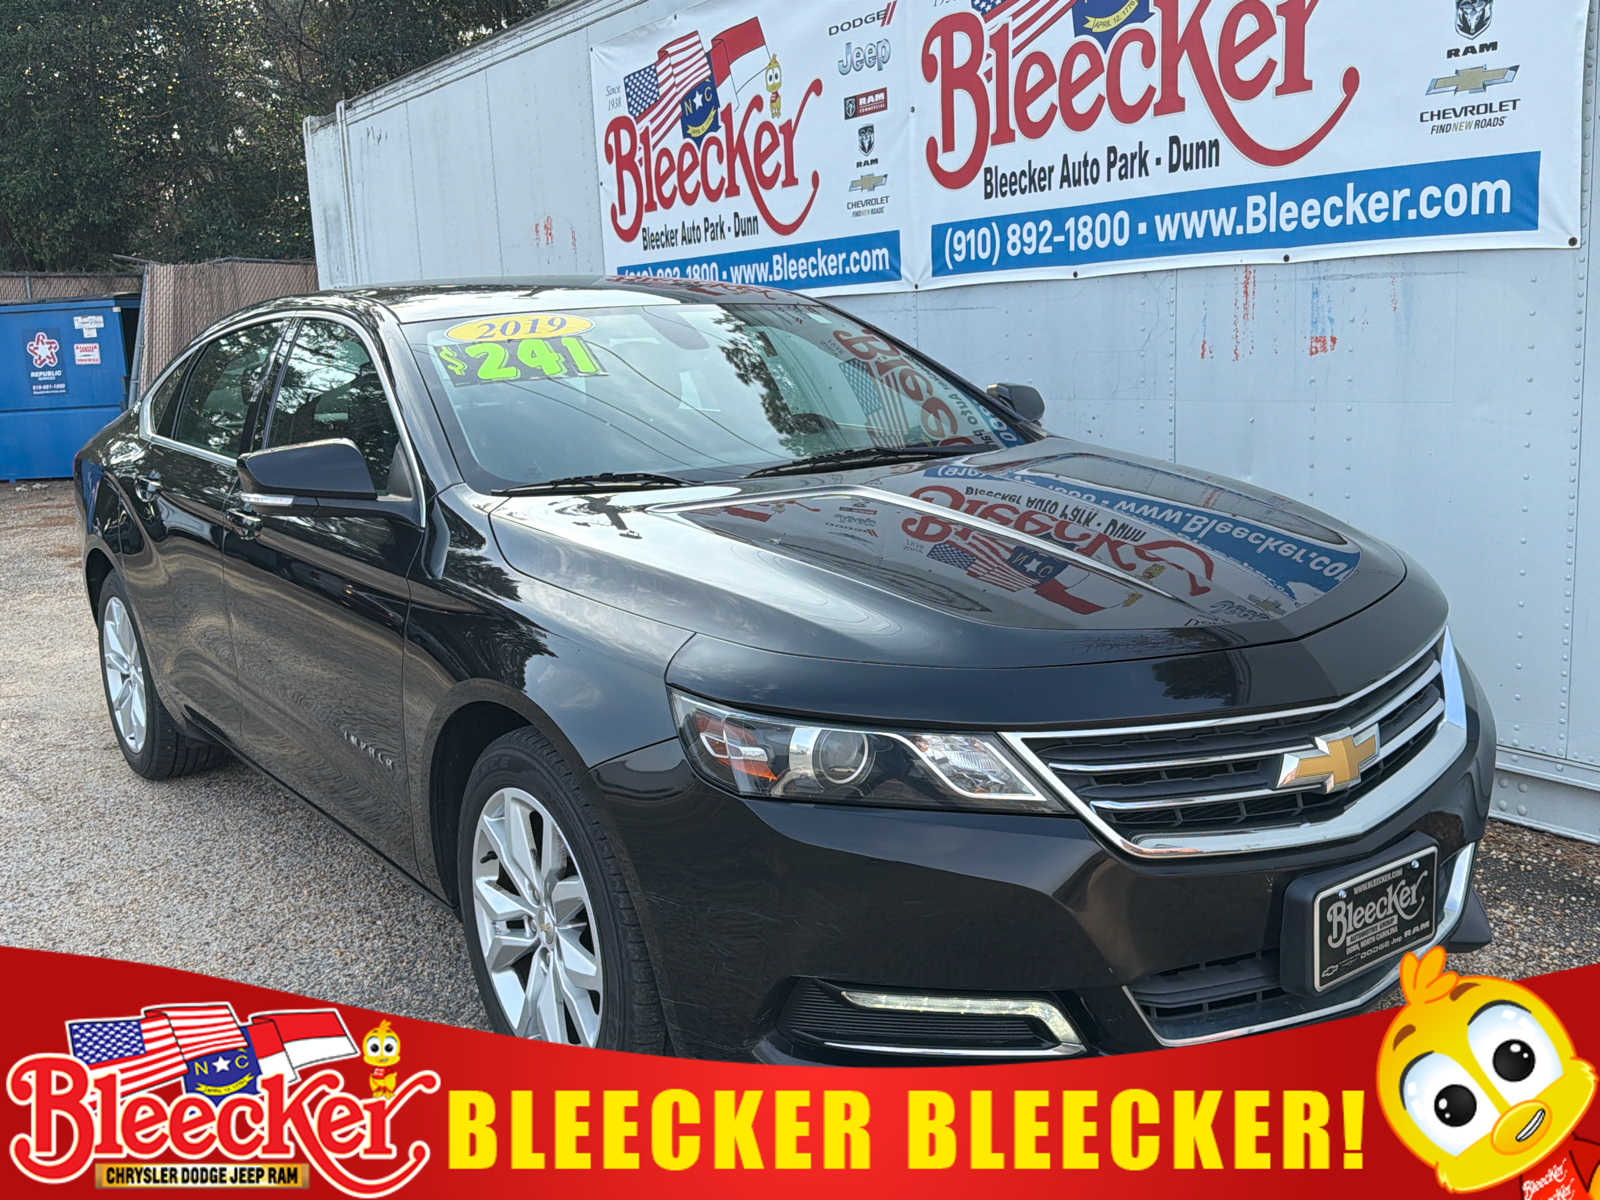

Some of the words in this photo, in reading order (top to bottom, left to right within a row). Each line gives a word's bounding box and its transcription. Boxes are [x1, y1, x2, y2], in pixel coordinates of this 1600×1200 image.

[828, 9, 887, 36] DODGE
[838, 38, 891, 76] Jeep
[1447, 41, 1498, 59] RAM
[860, 92, 885, 106] RAM
[921, 0, 1359, 189] Bleecker
[1420, 98, 1520, 122] CHEVROLET
[1474, 116, 1505, 130] ROADS
[604, 78, 823, 243] Bleecker
[856, 157, 878, 168] RAM
[983, 160, 1055, 200] Bleecker
[1059, 151, 1100, 190] Auto
[1106, 141, 1150, 183] Park
[1168, 135, 1220, 174] Dunn
[847, 195, 889, 211] CHEVROLET
[641, 224, 679, 251] Bleecker
[681, 219, 702, 245] Auto
[703, 215, 727, 242] Park
[733, 211, 759, 238] Dunn
[944, 222, 1001, 270] (910)
[1006, 210, 1130, 258] 892-1800
[1155, 178, 1511, 243] www.Bleecker.com
[730, 247, 890, 284] www.Bleecker.com
[476, 317, 567, 340] 2019
[440, 336, 600, 381] $241
[344, 729, 393, 771] IMPALA
[1326, 869, 1429, 949] Bleecker
[1404, 919, 1431, 938] RAM
